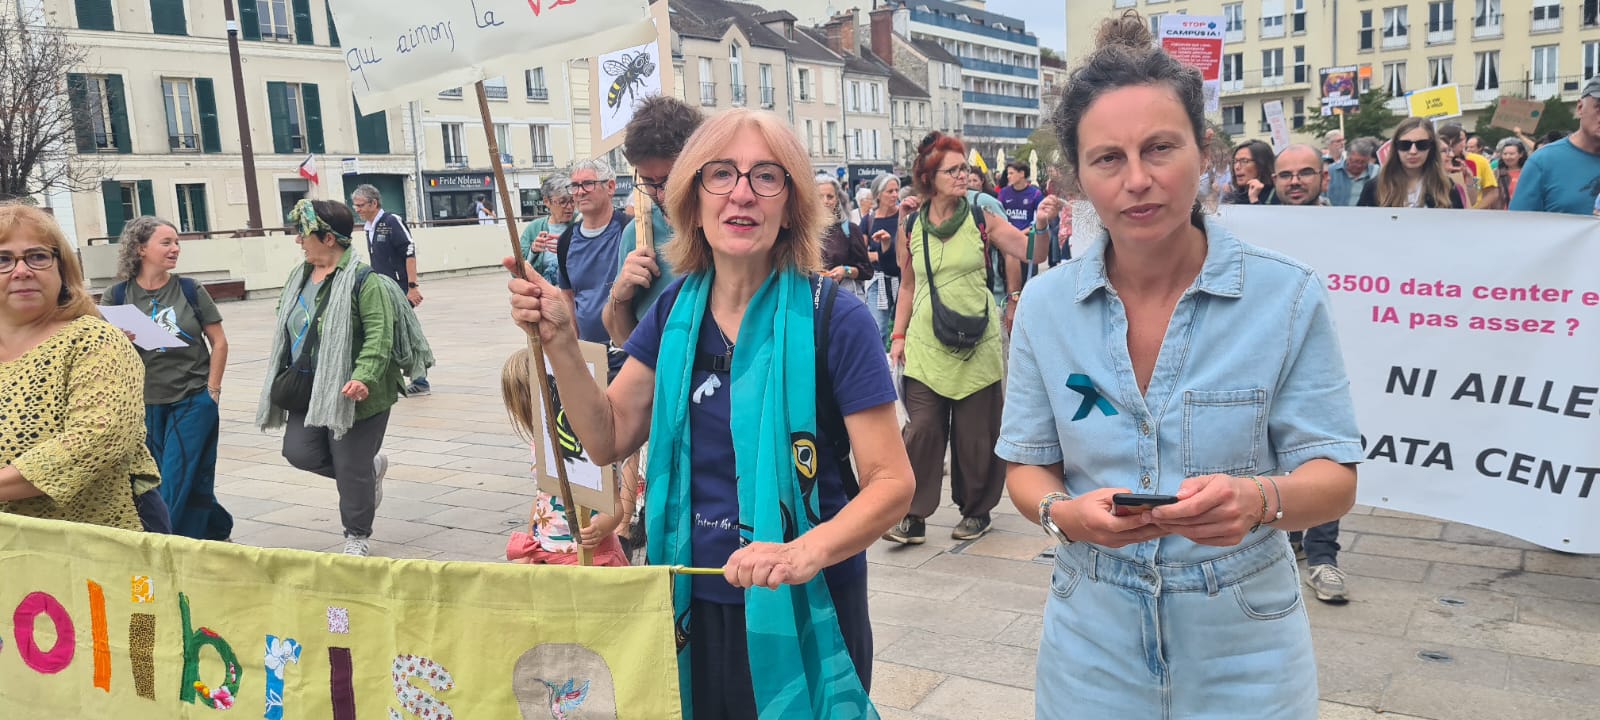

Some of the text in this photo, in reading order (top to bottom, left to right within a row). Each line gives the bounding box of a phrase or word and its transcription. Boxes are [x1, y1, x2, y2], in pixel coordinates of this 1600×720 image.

[346, 36, 382, 91] qui
[471, 0, 505, 29] la
[1166, 29, 1206, 37] CAMPUS
[1006, 208, 1028, 216] QATAR
[1327, 273, 1391, 294] 3500
[1399, 278, 1462, 298] data
[1472, 284, 1573, 304] center
[1372, 305, 1580, 337] IA pas assez ?
[1385, 365, 1600, 420] NI AILLE
[1360, 432, 1600, 499] ATA CENT
[0, 573, 456, 720] olibris
